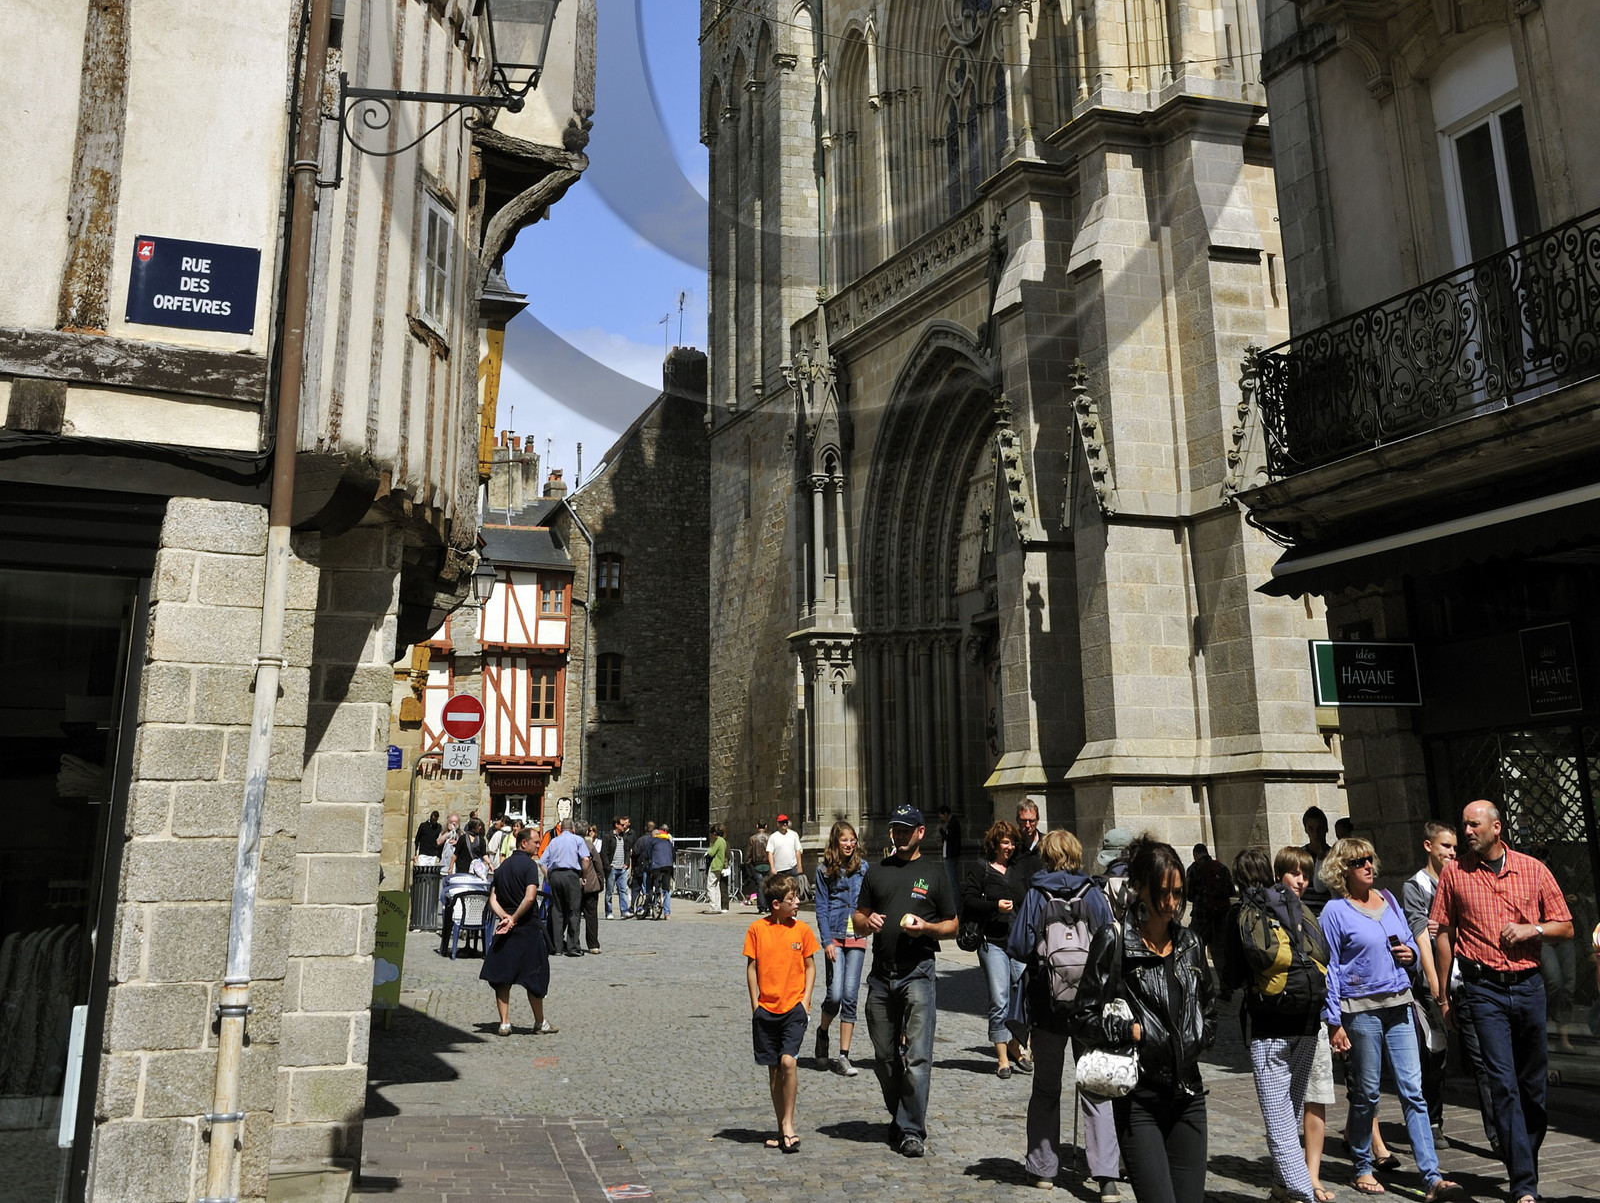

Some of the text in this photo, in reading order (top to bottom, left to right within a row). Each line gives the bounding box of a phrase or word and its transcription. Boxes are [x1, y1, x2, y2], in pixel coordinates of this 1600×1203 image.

[181, 256, 211, 274] RUE
[179, 276, 210, 294] DES
[153, 294, 232, 316] ORFEVRES
[1355, 648, 1377, 660] idées
[1341, 665, 1396, 685] HAVANE
[1530, 666, 1573, 688] HAVANE
[492, 778, 543, 787] MEGALITHES
